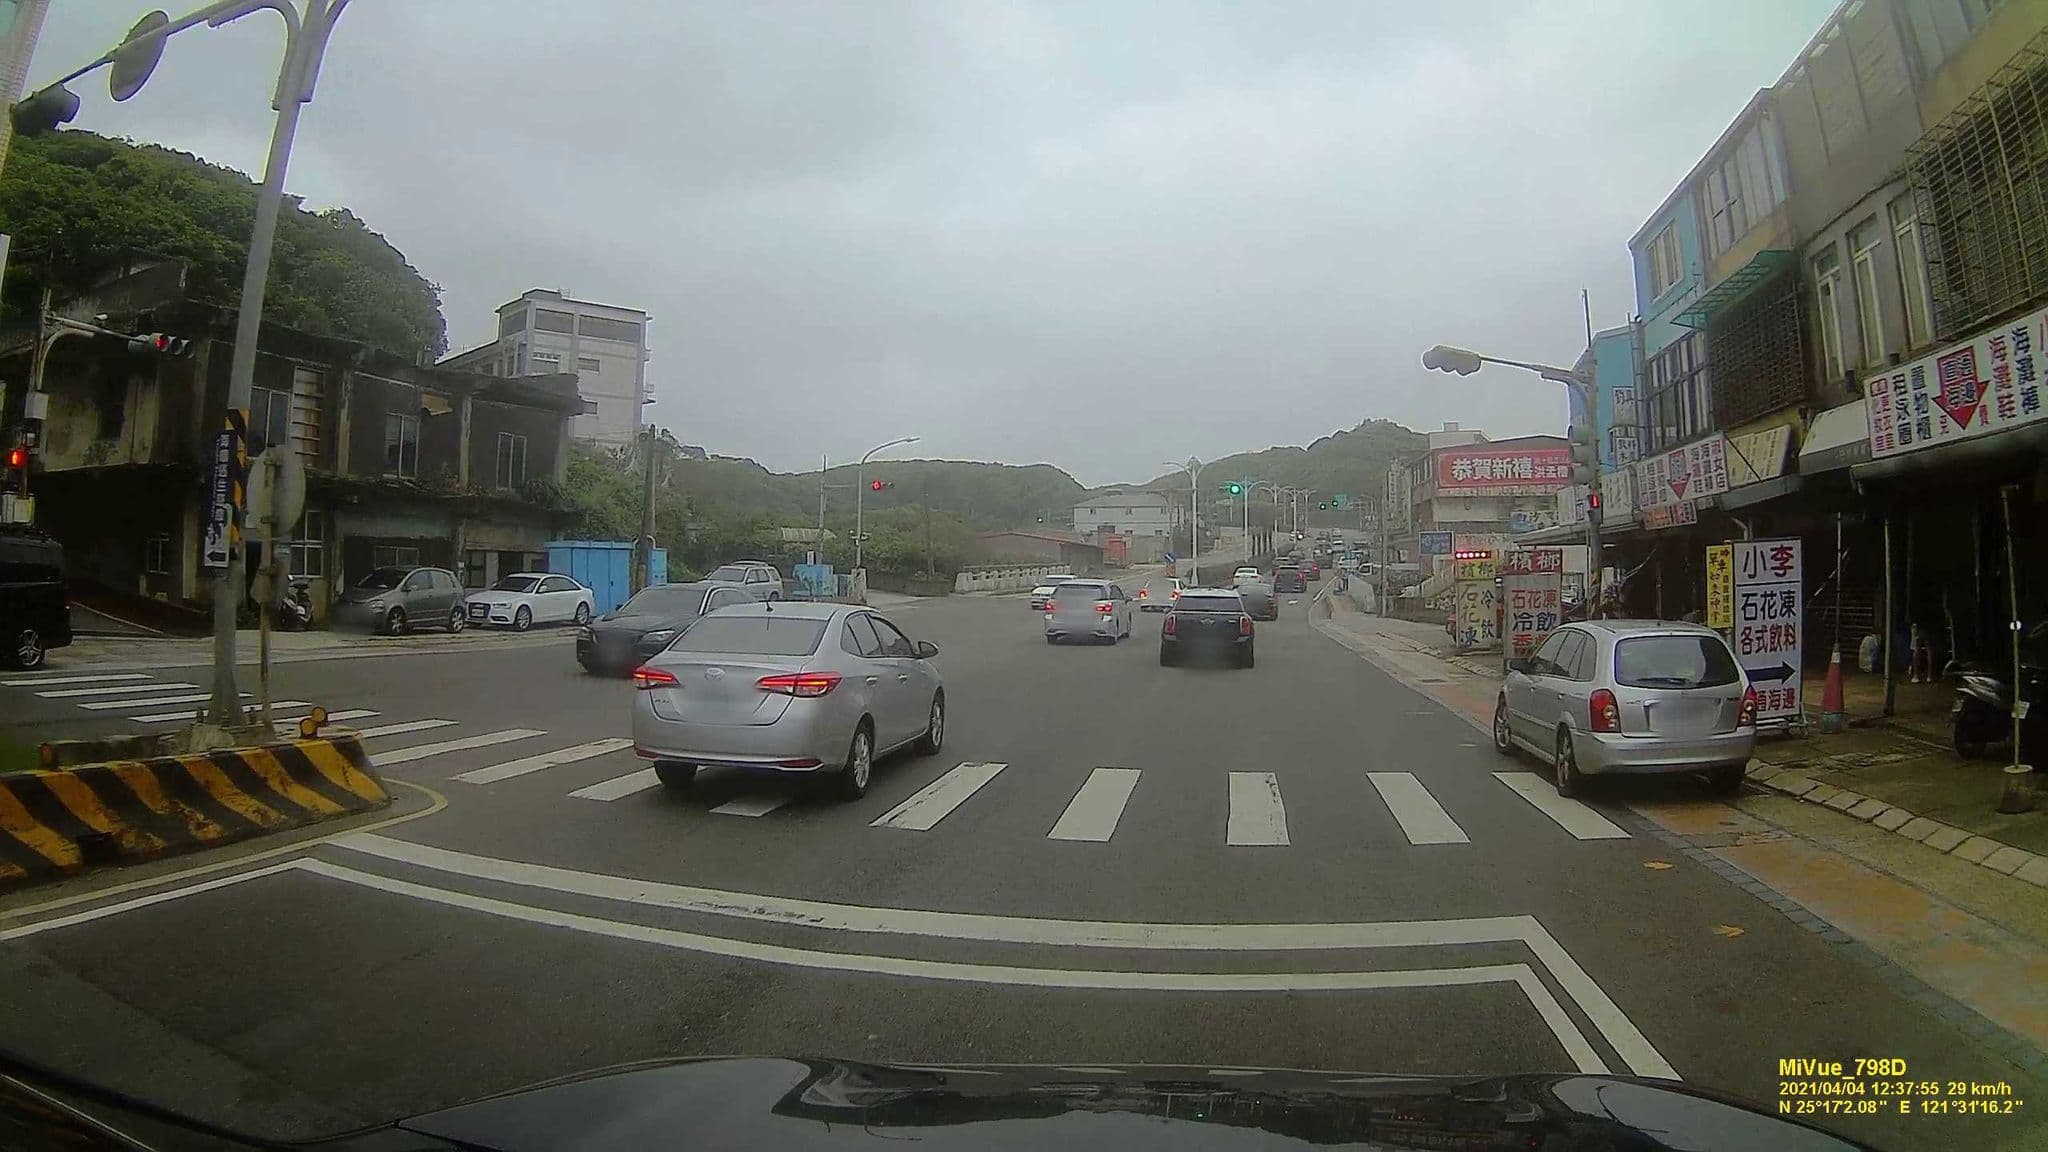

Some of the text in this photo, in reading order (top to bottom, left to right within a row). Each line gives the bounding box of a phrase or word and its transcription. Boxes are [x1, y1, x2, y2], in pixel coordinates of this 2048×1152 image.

[1452, 457, 1533, 481] 恭賀新禧
[1510, 551, 1560, 571] 檳榔
[1743, 544, 1795, 579] 小李
[1512, 589, 1557, 609] 石花凍
[1741, 590, 1796, 621] 石花凍
[1512, 612, 1557, 632] 冷飲
[1740, 622, 1796, 655] 各式飲料
